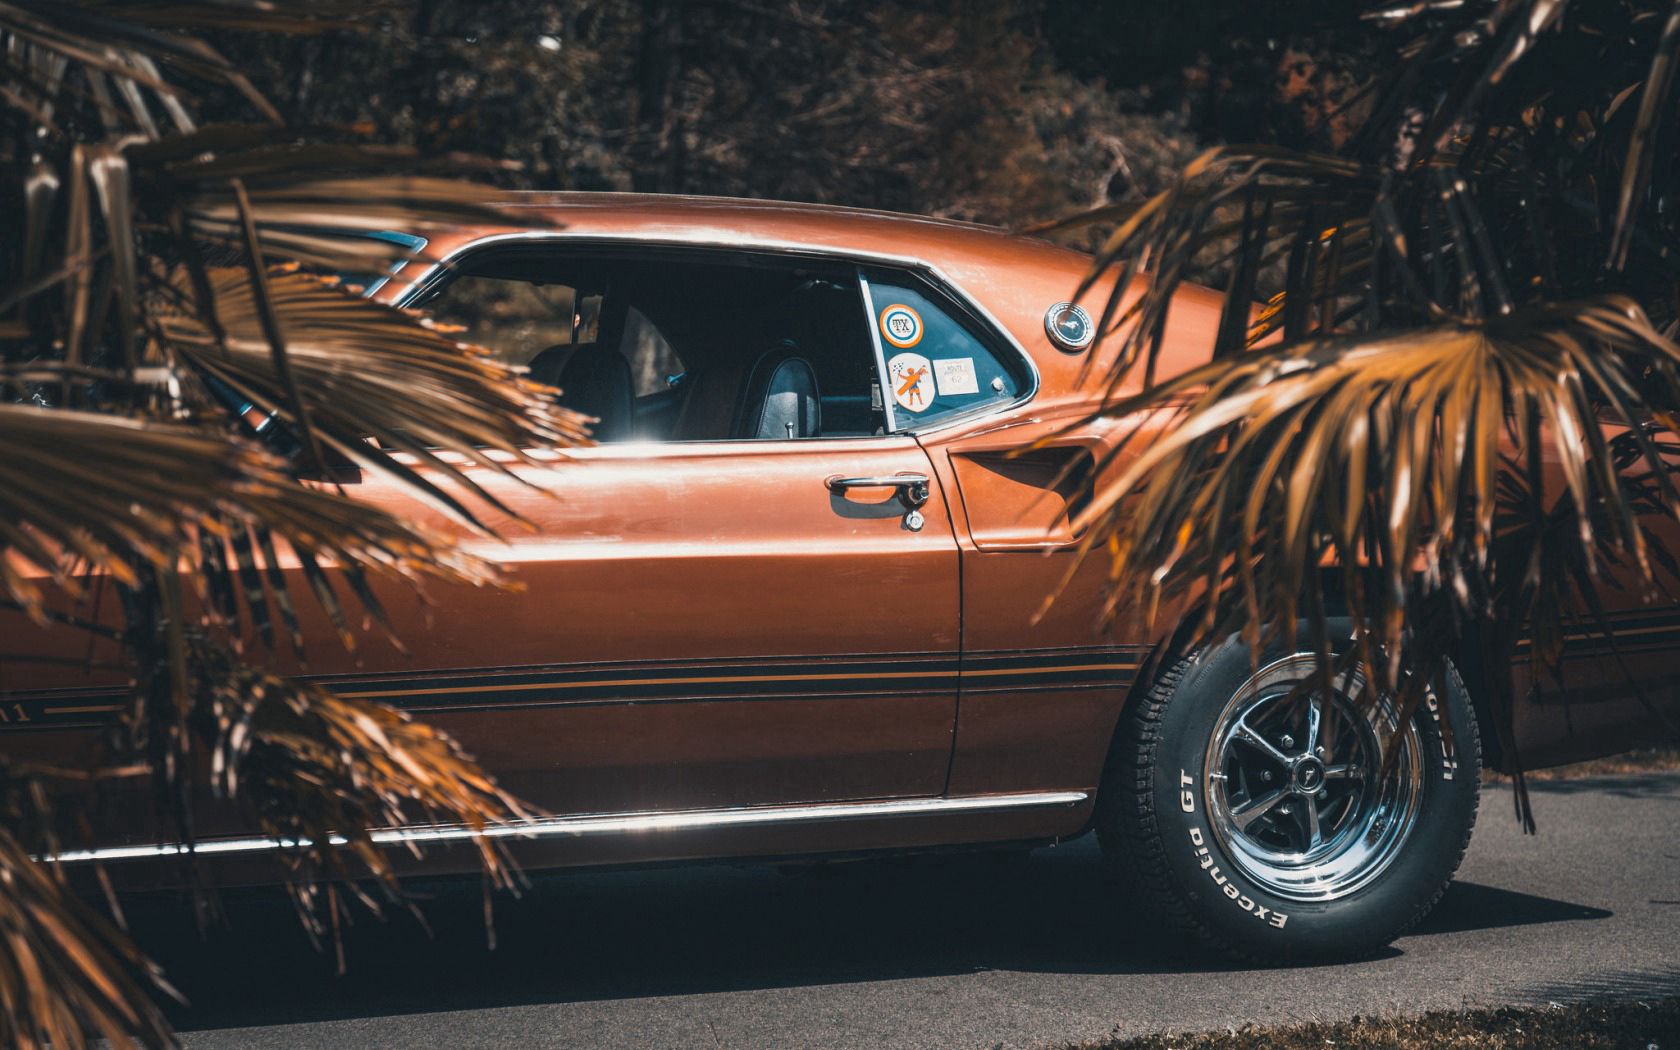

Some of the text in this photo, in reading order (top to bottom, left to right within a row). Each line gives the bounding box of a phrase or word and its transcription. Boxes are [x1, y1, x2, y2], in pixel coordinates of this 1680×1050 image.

[892, 318, 910, 331] TX
[1180, 768, 1289, 929] Excentia GT
